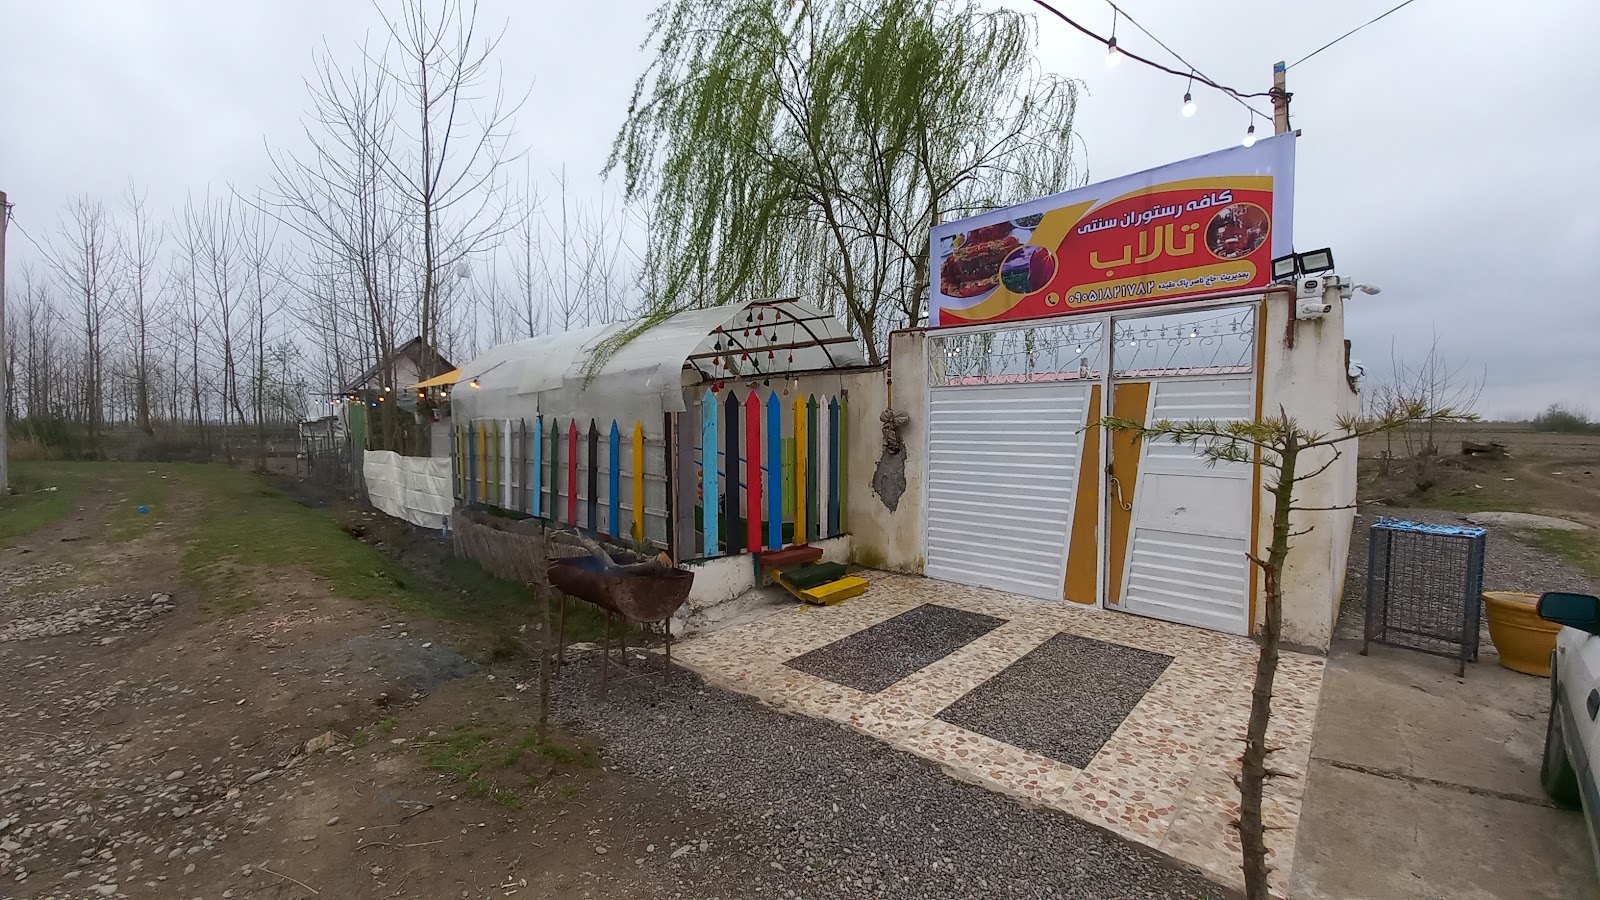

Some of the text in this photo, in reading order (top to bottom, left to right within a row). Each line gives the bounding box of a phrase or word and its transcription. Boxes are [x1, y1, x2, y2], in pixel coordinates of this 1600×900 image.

[1077, 189, 1233, 235] کافه رستوران سنتی
[1090, 222, 1200, 277] تالاب
[1177, 279, 1189, 289] پاک
[1190, 277, 1204, 288] ناصر
